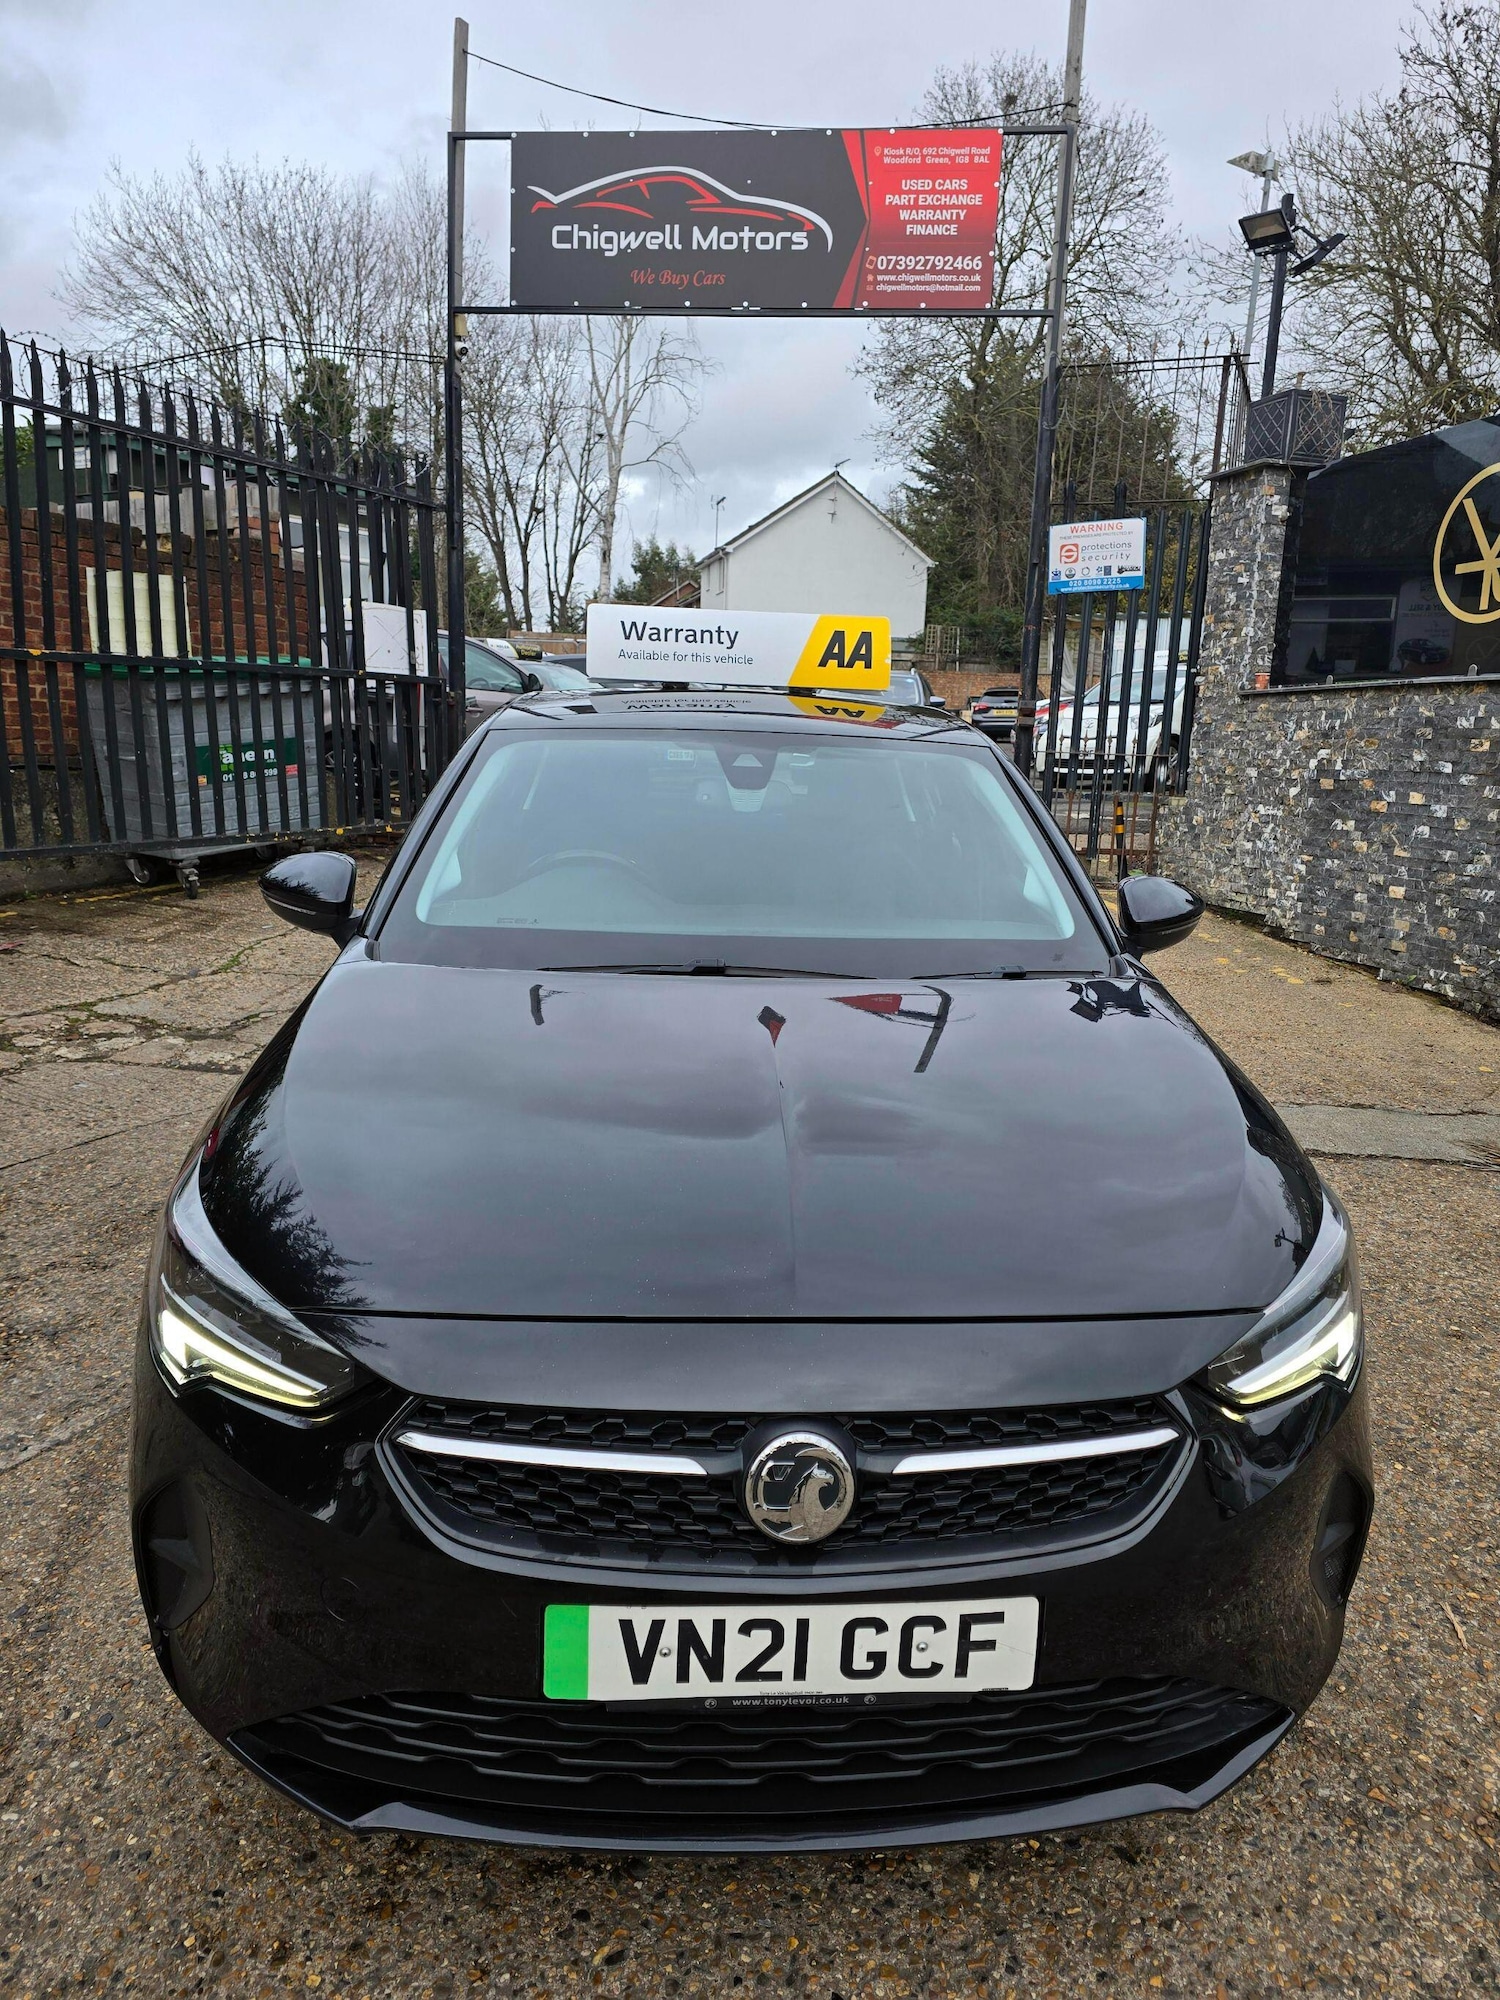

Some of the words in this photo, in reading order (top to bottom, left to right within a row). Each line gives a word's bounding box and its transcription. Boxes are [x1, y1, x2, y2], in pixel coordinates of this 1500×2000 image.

[884, 147, 904, 156] Kiosk
[905, 147, 921, 157] R/O,
[922, 147, 937, 155] 692
[938, 146, 970, 156] Chigwell
[971, 146, 990, 155] Road
[883, 156, 921, 164] Woodford
[926, 156, 951, 164] Green,
[956, 156, 970, 164] IG8
[974, 156, 990, 164] 8AL
[901, 179, 932, 190] USED
[935, 179, 968, 190] CARS
[885, 194, 917, 206] PART
[918, 194, 983, 206] EXCHANGE
[899, 209, 967, 220] WARRANTY
[906, 224, 958, 236] FINANCE
[551, 224, 683, 257] Chigwell
[692, 225, 809, 251] Motors
[877, 256, 982, 270] 07392792466
[630, 268, 655, 286] We
[659, 270, 690, 290] Buy
[693, 270, 727, 287] Cars
[876, 273, 982, 284] www.chigwellmotors.co.uk
[876, 284, 981, 292] chigwellmotors@hotmail.com
[1070, 522, 1124, 534] WARNING
[1081, 541, 1132, 552] protections
[1081, 552, 1131, 562] security
[620, 620, 740, 649] Warranty
[817, 630, 873, 670] AA
[618, 648, 670, 662] Available
[672, 651, 689, 662] for
[690, 652, 711, 664] this
[714, 654, 754, 665] vehicle
[222, 748, 275, 764] aen
[618, 1618, 810, 1685] VN21
[839, 1611, 1005, 1680] GCF
[732, 1696, 850, 1706] www.tonylevoi.co.uk
